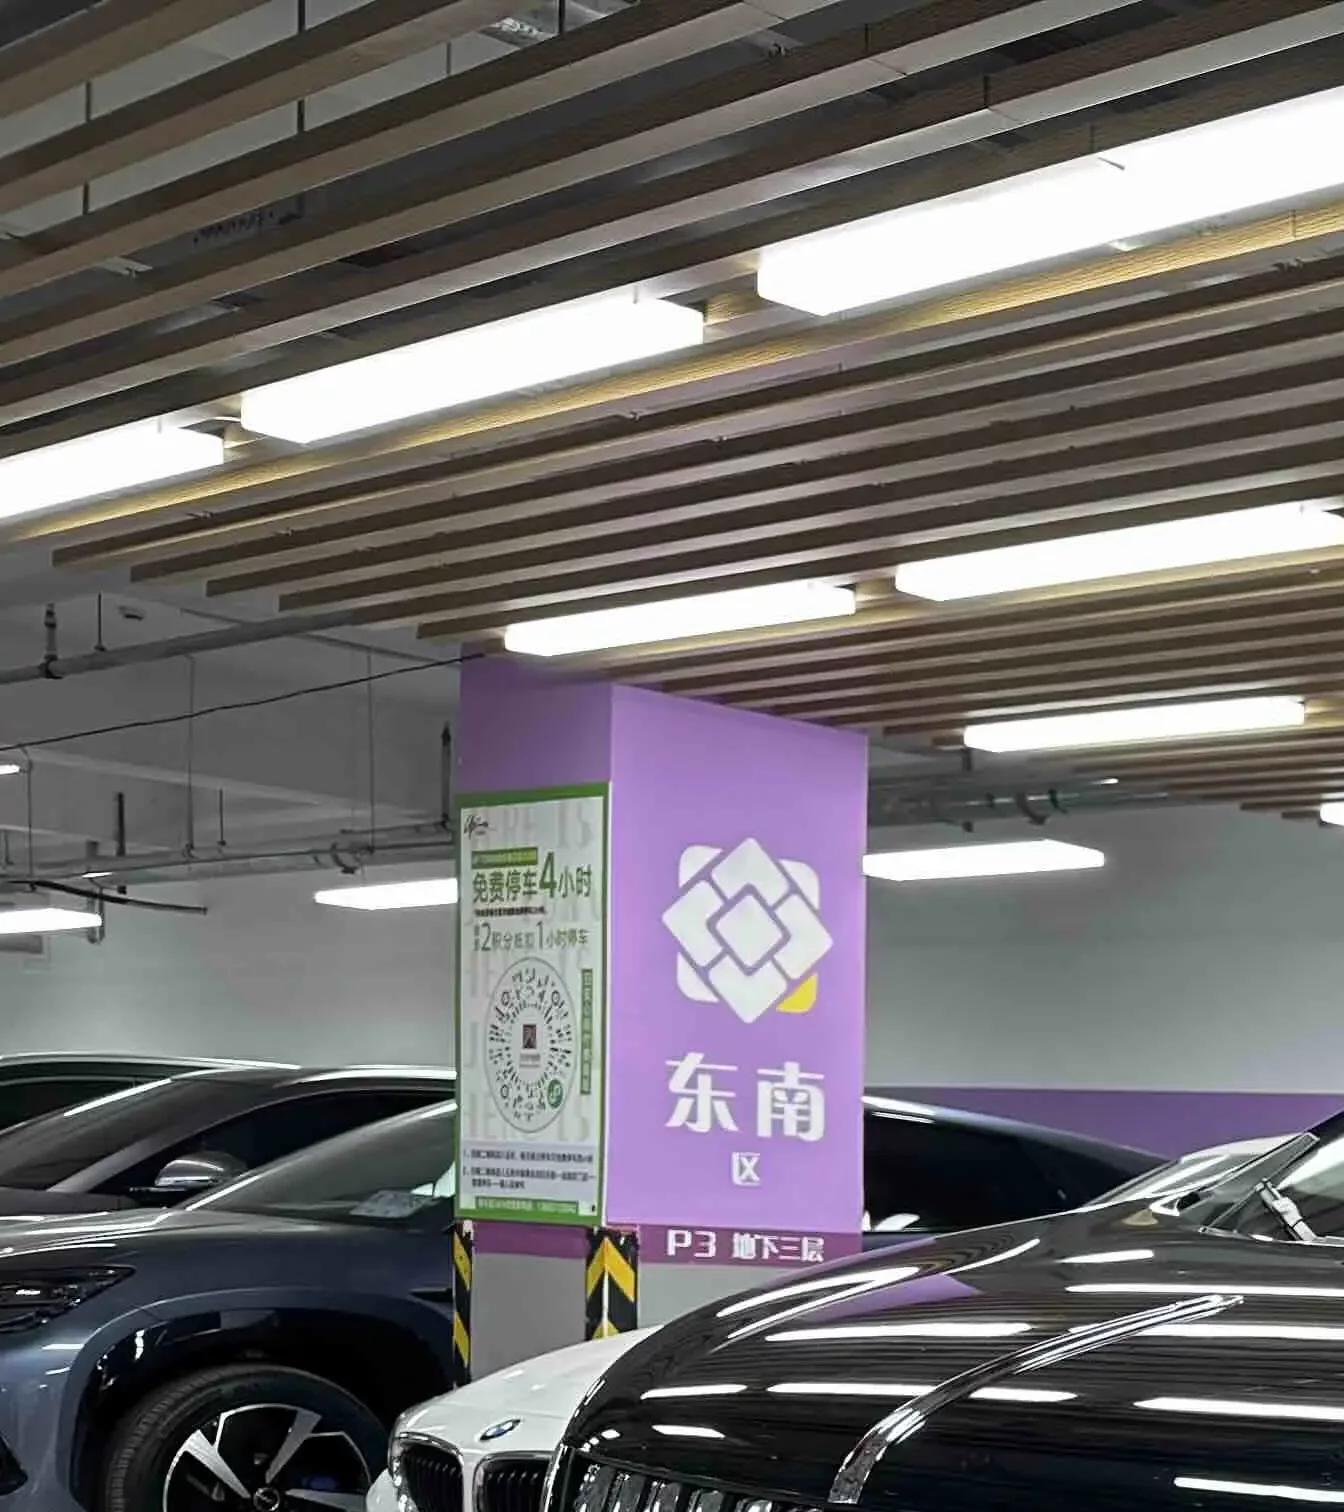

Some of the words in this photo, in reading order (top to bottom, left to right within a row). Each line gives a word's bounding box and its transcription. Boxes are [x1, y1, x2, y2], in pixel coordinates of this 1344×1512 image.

[472, 851, 592, 903] 免费停车4小时
[664, 1052, 825, 1142] 东南
[731, 1152, 761, 1186] 区
[667, 1229, 717, 1258] P3
[732, 1232, 825, 1262] 地下三层
